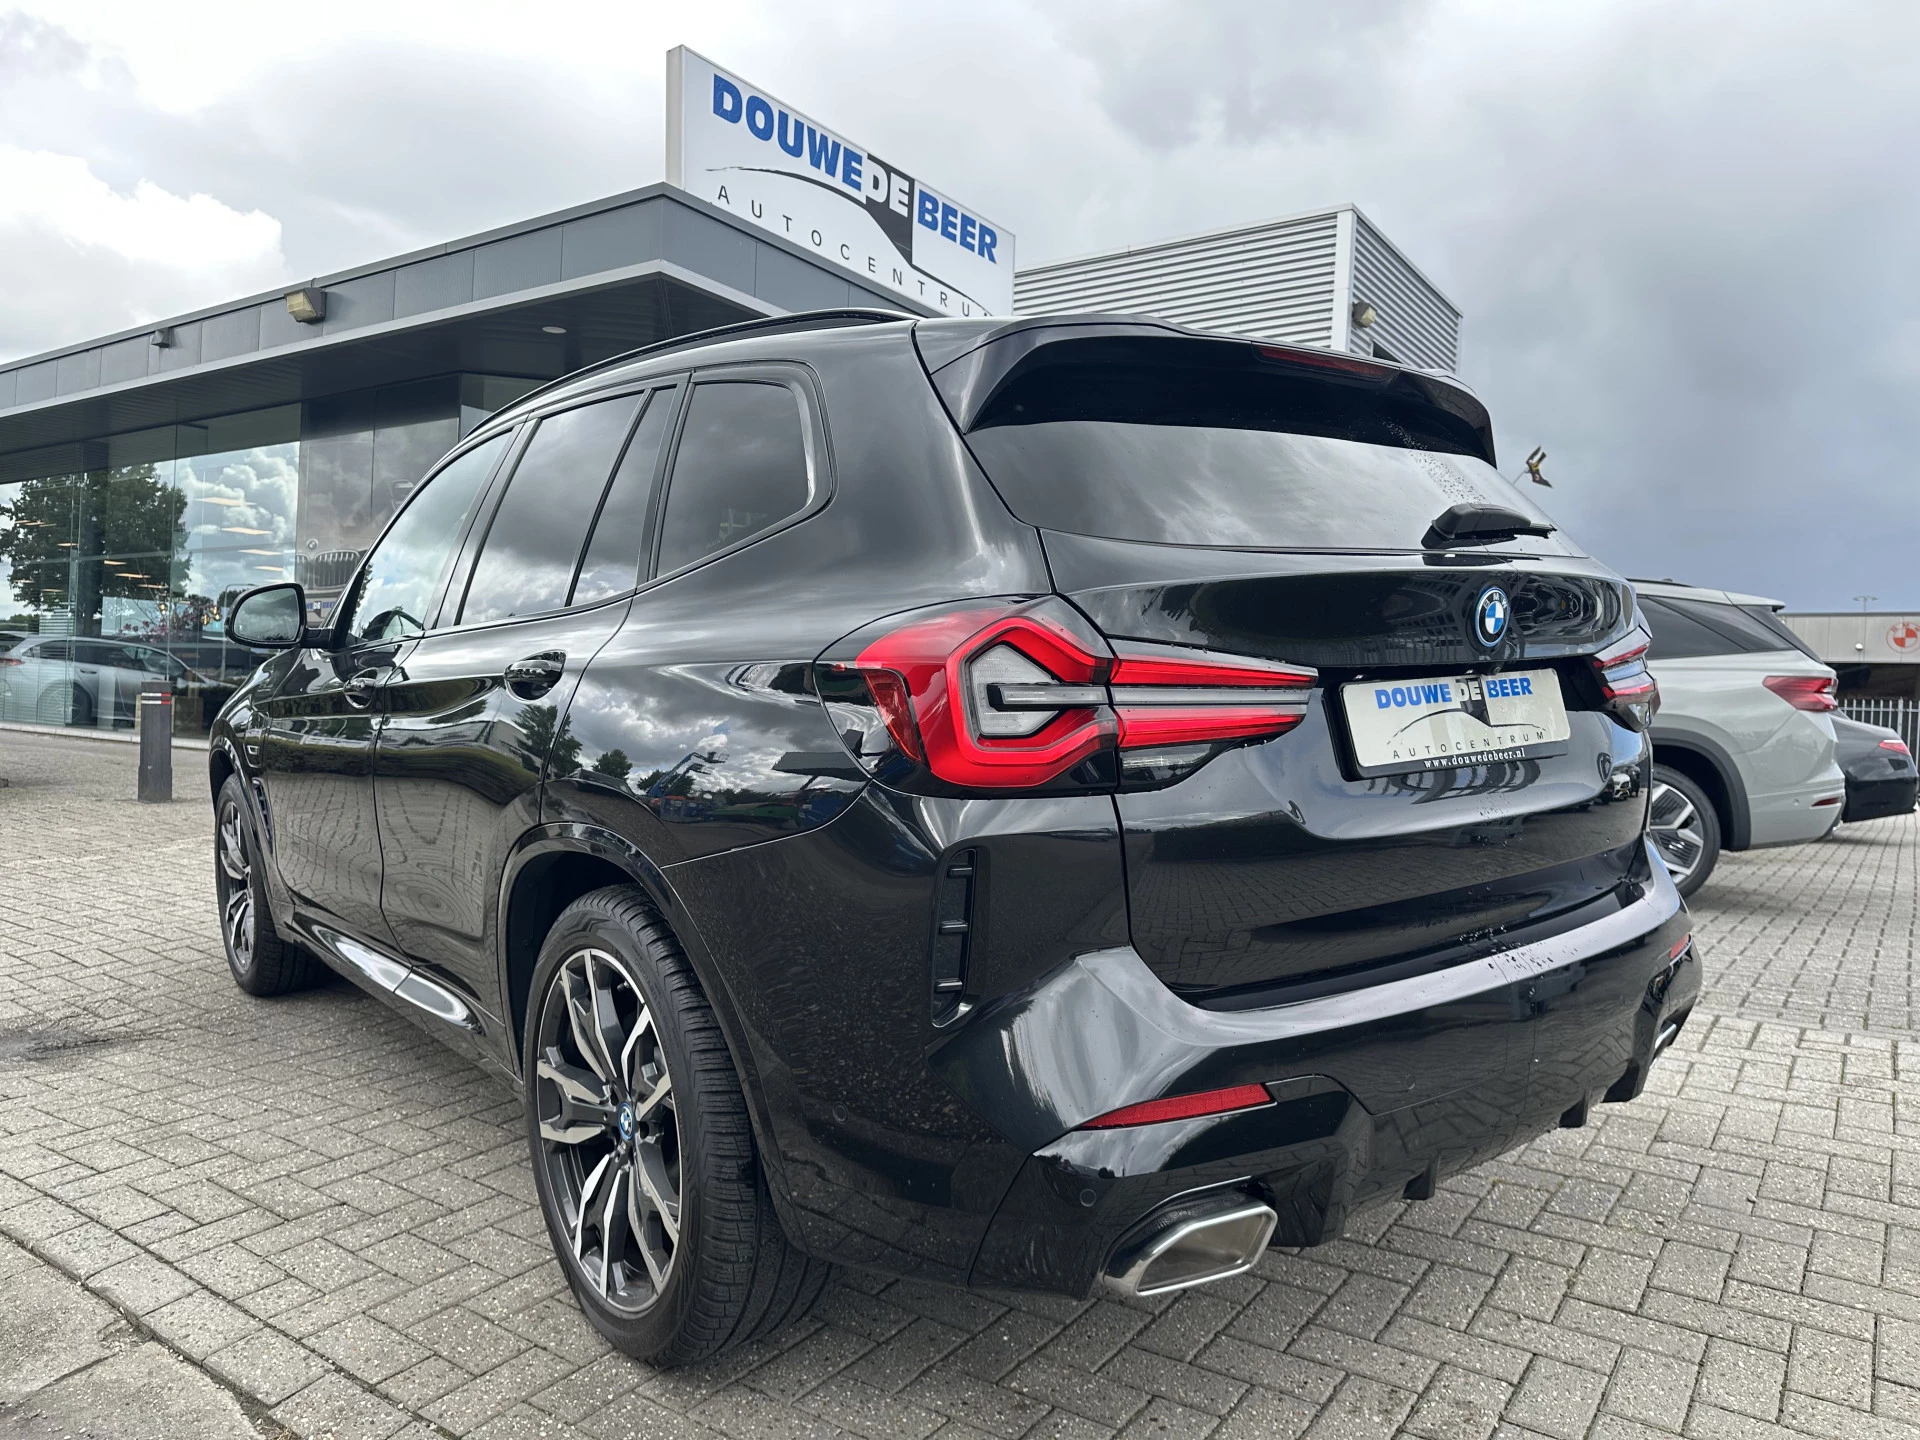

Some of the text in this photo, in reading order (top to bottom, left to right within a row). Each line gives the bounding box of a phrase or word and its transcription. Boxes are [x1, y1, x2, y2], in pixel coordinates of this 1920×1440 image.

[713, 73, 998, 264] DOUWE DE BEER
[717, 185, 988, 317] AUTOCENTRU
[1375, 677, 1533, 709] DOUWE DE BEER
[1393, 731, 1544, 759] AUTOCENTRUM
[1424, 747, 1526, 768] www.douwedebeer.nl
